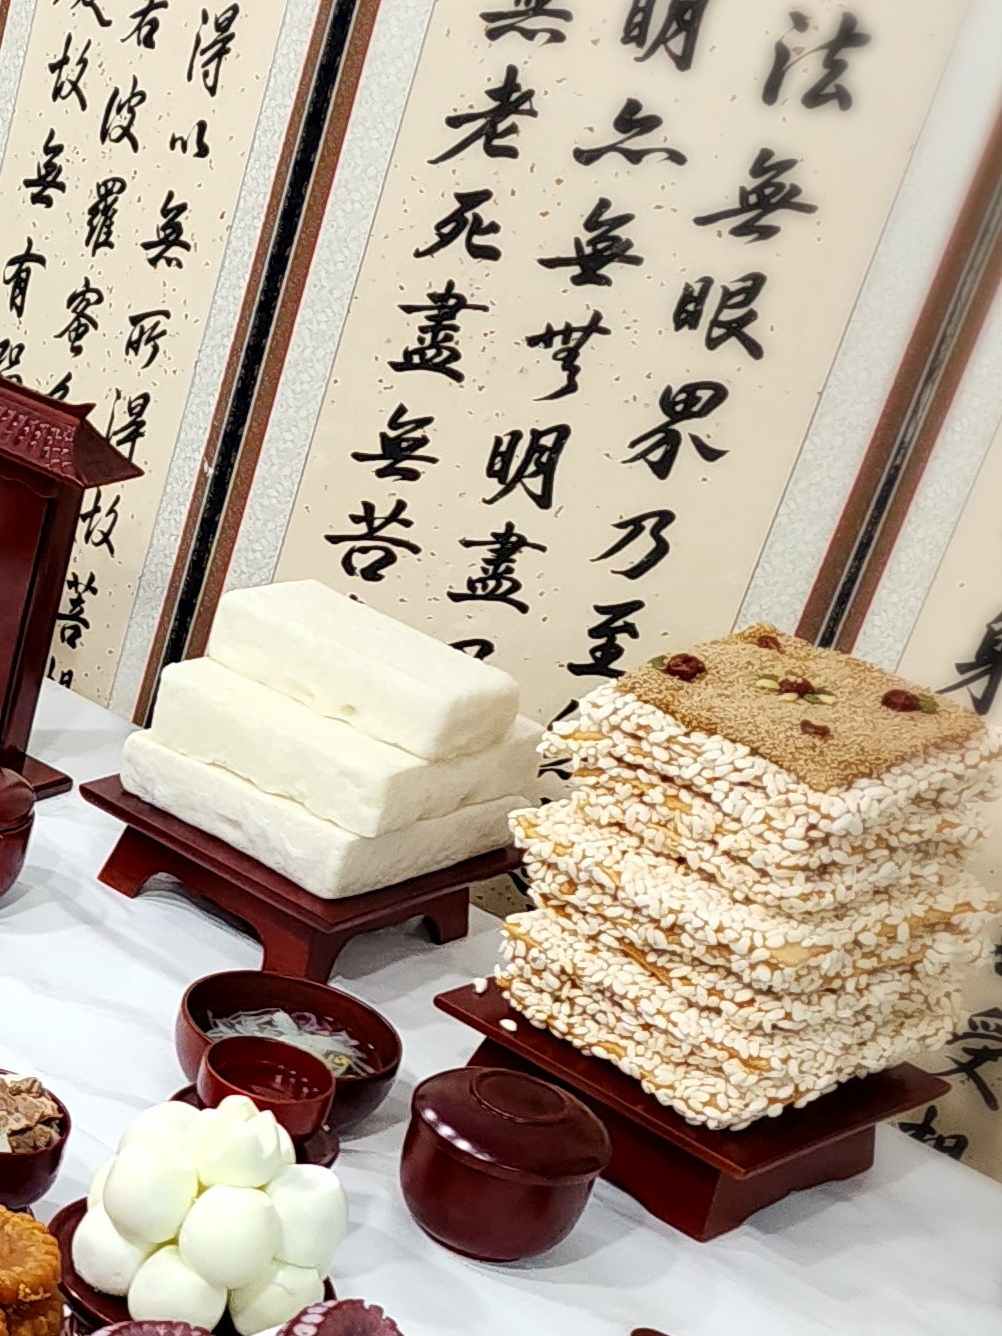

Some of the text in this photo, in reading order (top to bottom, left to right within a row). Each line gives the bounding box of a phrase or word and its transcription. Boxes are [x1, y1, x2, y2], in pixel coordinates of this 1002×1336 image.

[445, 0, 708, 661] 明亦無無明盡
[536, 12, 872, 781] 法無眼界乃至
